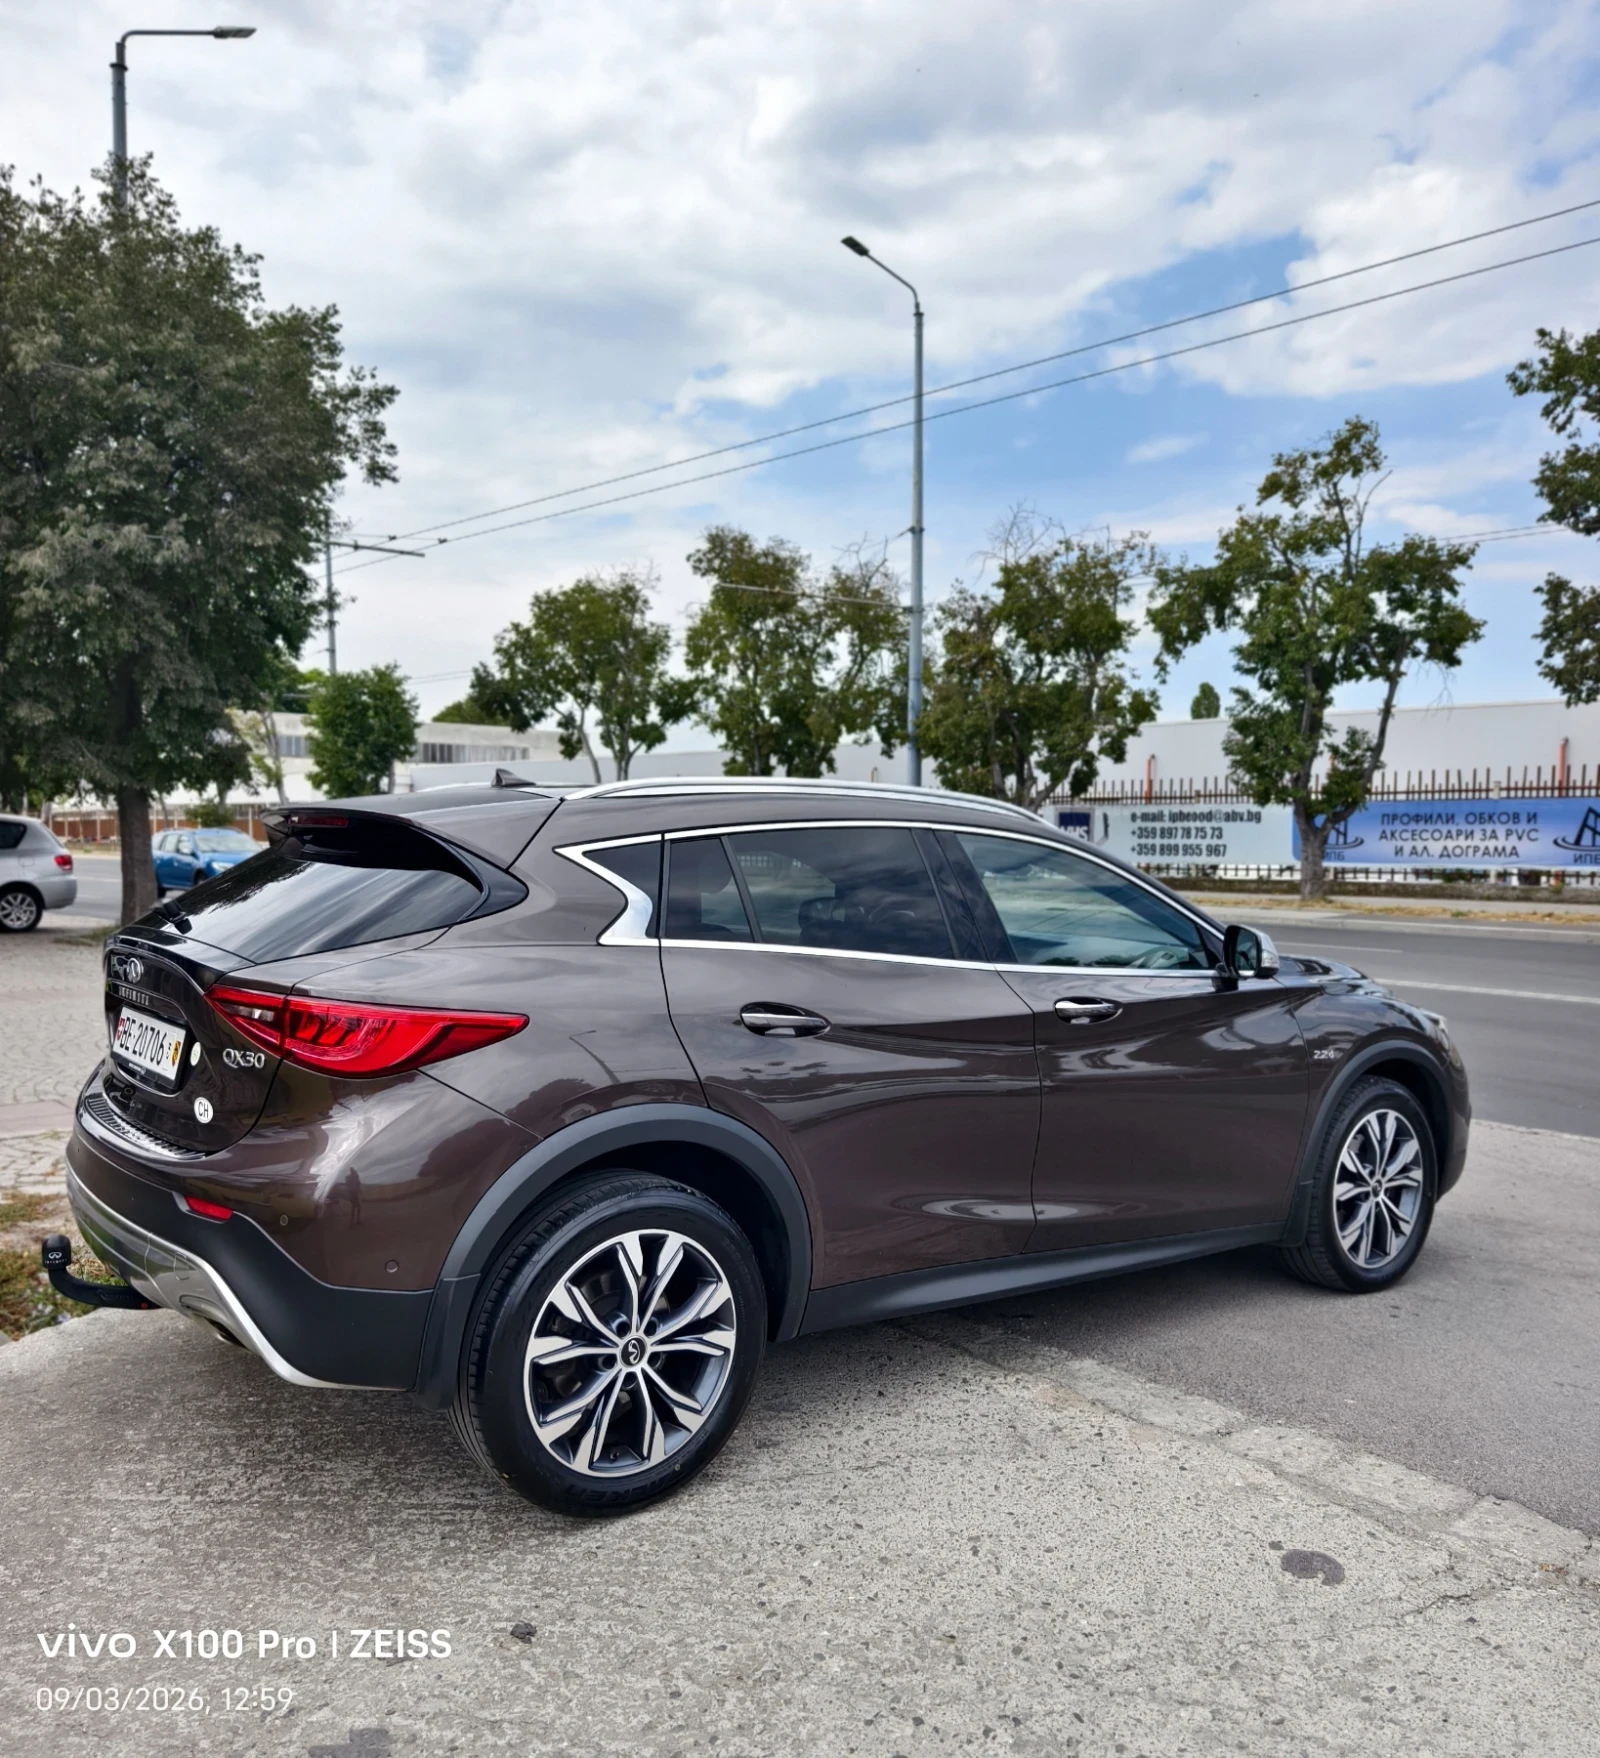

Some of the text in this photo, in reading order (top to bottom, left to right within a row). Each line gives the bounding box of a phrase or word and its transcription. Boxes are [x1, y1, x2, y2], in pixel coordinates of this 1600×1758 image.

[1131, 809, 1262, 824] e-mail: ipbeood@abv.bg
[1381, 811, 1538, 826] ПРОФИЛИ, ОБКОВ И
[1131, 826, 1223, 839] +359 897 78 75 73
[1379, 828, 1540, 842] АКСЕСОАРИ ЗА PVC
[1131, 843, 1227, 857] +359 899 955 967
[1394, 844, 1520, 859] И АЛ. ДОГРАМА
[222, 1048, 265, 1069] QX30
[197, 1101, 209, 1119] CH
